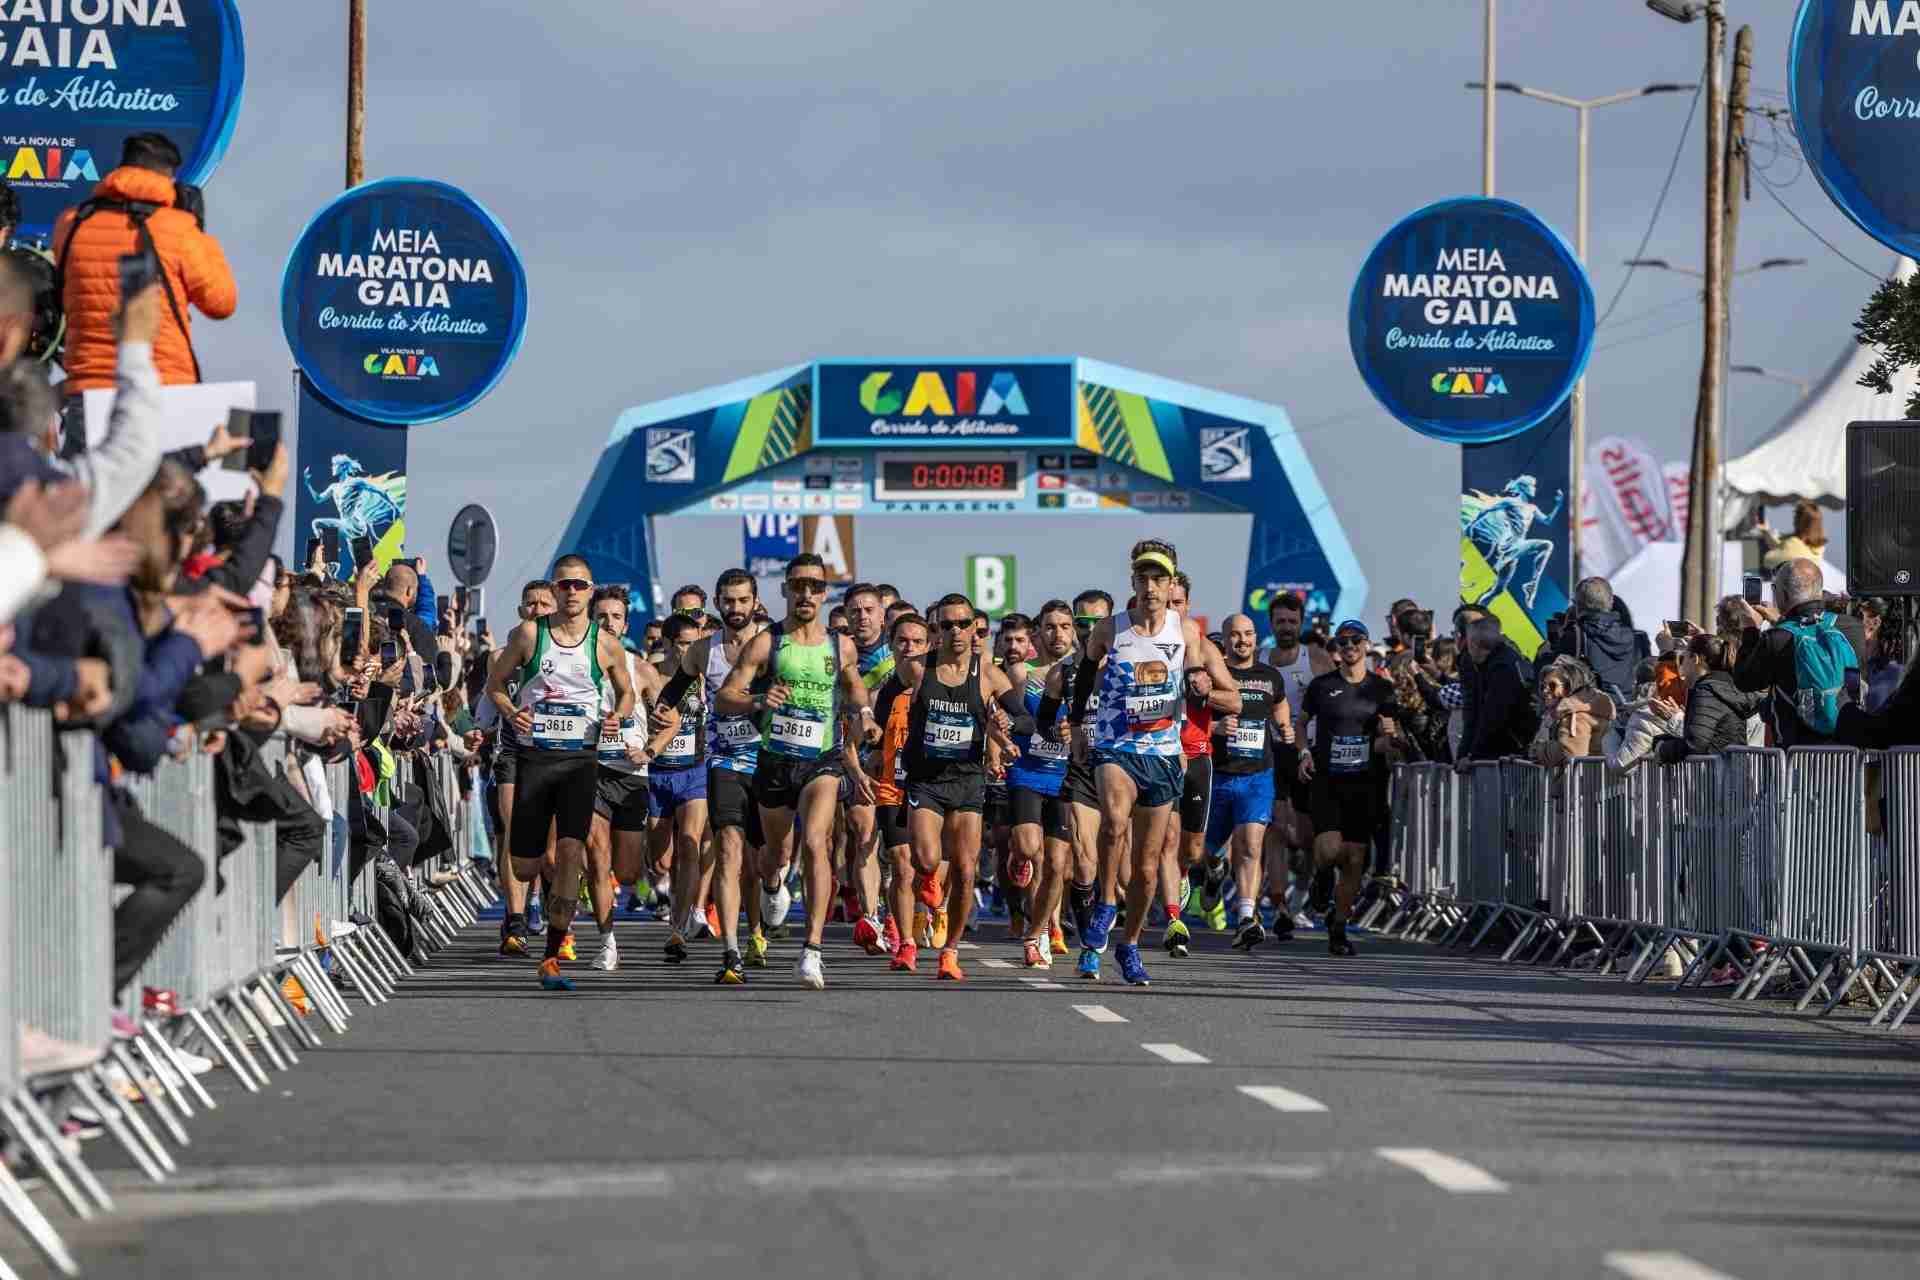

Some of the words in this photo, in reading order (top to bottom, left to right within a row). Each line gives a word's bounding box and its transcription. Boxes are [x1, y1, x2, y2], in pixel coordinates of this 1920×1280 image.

[0, 26, 117, 70] AIA
[15, 76, 49, 106] do
[50, 75, 179, 111] Atlântico
[3, 136, 26, 145] VILA
[29, 136, 59, 146] NOVA
[61, 138, 76, 147] DE
[0, 146, 100, 181] AIA
[372, 228, 441, 253] MEIA
[317, 253, 493, 283] MARATONA
[1436, 248, 1507, 271] MEIA
[358, 280, 451, 309] GAIA
[1382, 274, 1560, 299] MARATONA
[318, 307, 385, 330] Corrida
[388, 311, 408, 330] do
[409, 311, 488, 334] Atlântico
[1424, 300, 1518, 326] GAIA
[1386, 327, 1452, 349] Corrida
[1454, 330, 1476, 349] do
[1477, 330, 1555, 351] Atlântico
[870, 418, 928, 435] Corrida
[930, 418, 949, 435] do
[950, 418, 1019, 436] Atlântico
[911, 463, 1005, 488] 0:00:08
[745, 514, 799, 538] VIP
[813, 515, 849, 576] A
[975, 558, 1006, 610] B
[784, 721, 812, 738] 3618
[936, 728, 960, 742] 1021
